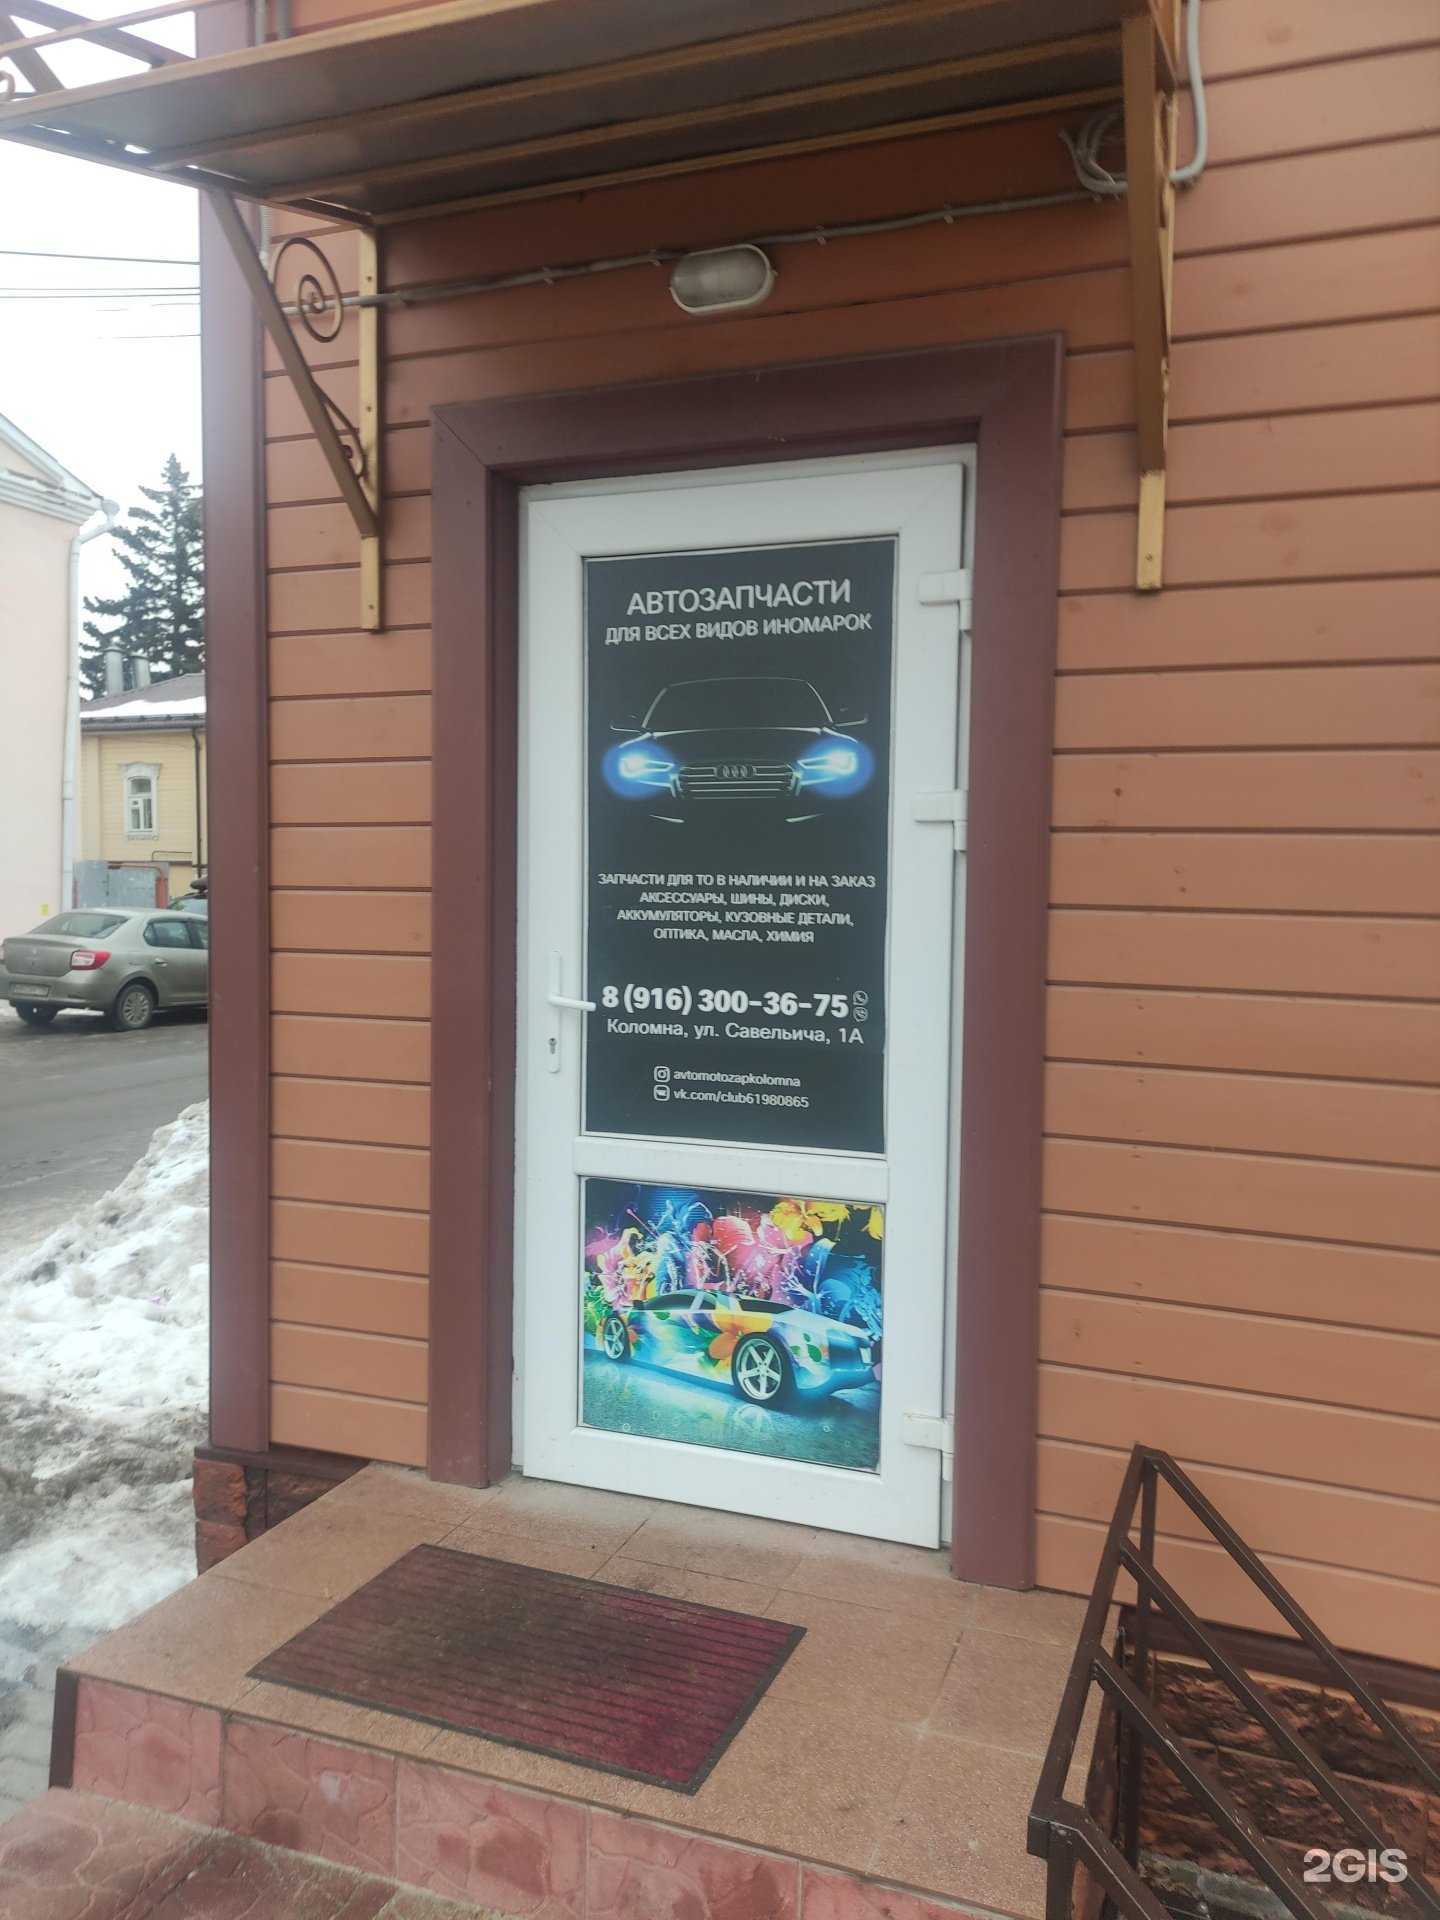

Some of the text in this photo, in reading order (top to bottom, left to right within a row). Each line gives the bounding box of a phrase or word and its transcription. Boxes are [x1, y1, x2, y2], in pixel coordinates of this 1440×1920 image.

[627, 579, 851, 615] АВТОЗАПЧАСТИ
[605, 612, 873, 645] ДЛЯ ВСЕХ ВИДОВ ИНОМАРОК
[598, 873, 876, 888] ЗАПЧАСТИ ДЛЯ ТО В НАЛИЧИИ И НА ЗАКАЗ
[640, 892, 830, 908] АКСЕССУАРЫ, ШИНЫ, ДИСКИ,
[617, 909, 854, 927] АККУМУЛЯТОРЫ, КУЗОВНЫЕ ДЕТАЛИ,
[653, 928, 815, 943] ОПТИКА, МАСЛА, ХИМИЯ
[602, 984, 850, 1018] 8 (916) 300-36-75
[607, 1018, 689, 1038] Коломна,
[694, 1024, 720, 1039] ул.
[725, 1023, 831, 1045] Савельича,
[674, 1069, 801, 1087] avtomotozapkolomna
[674, 1088, 809, 1108] vk.com/club61980865
